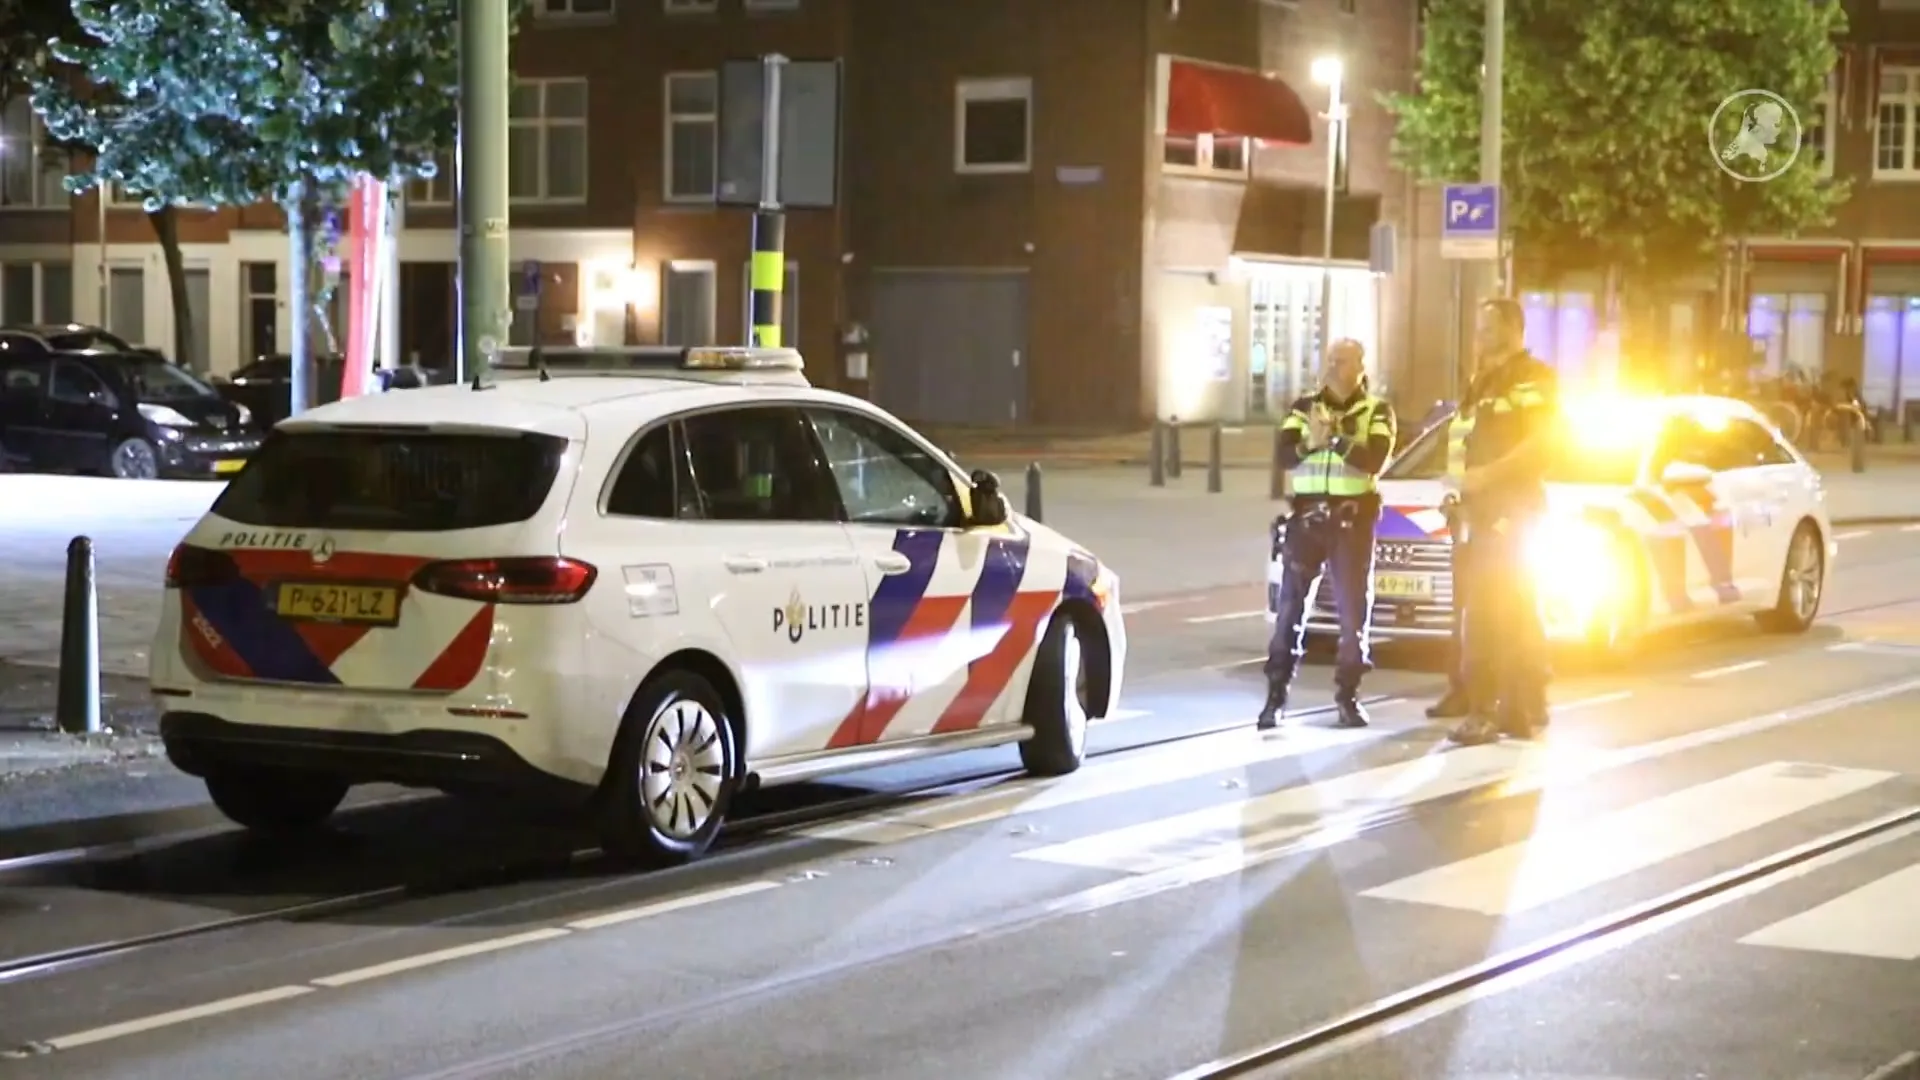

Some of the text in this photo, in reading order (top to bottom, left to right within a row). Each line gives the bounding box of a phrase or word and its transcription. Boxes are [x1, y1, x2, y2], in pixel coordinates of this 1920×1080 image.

[219, 531, 307, 548] POLITIE
[289, 587, 384, 616] P-621-LZ
[773, 602, 864, 644] POLITIE
